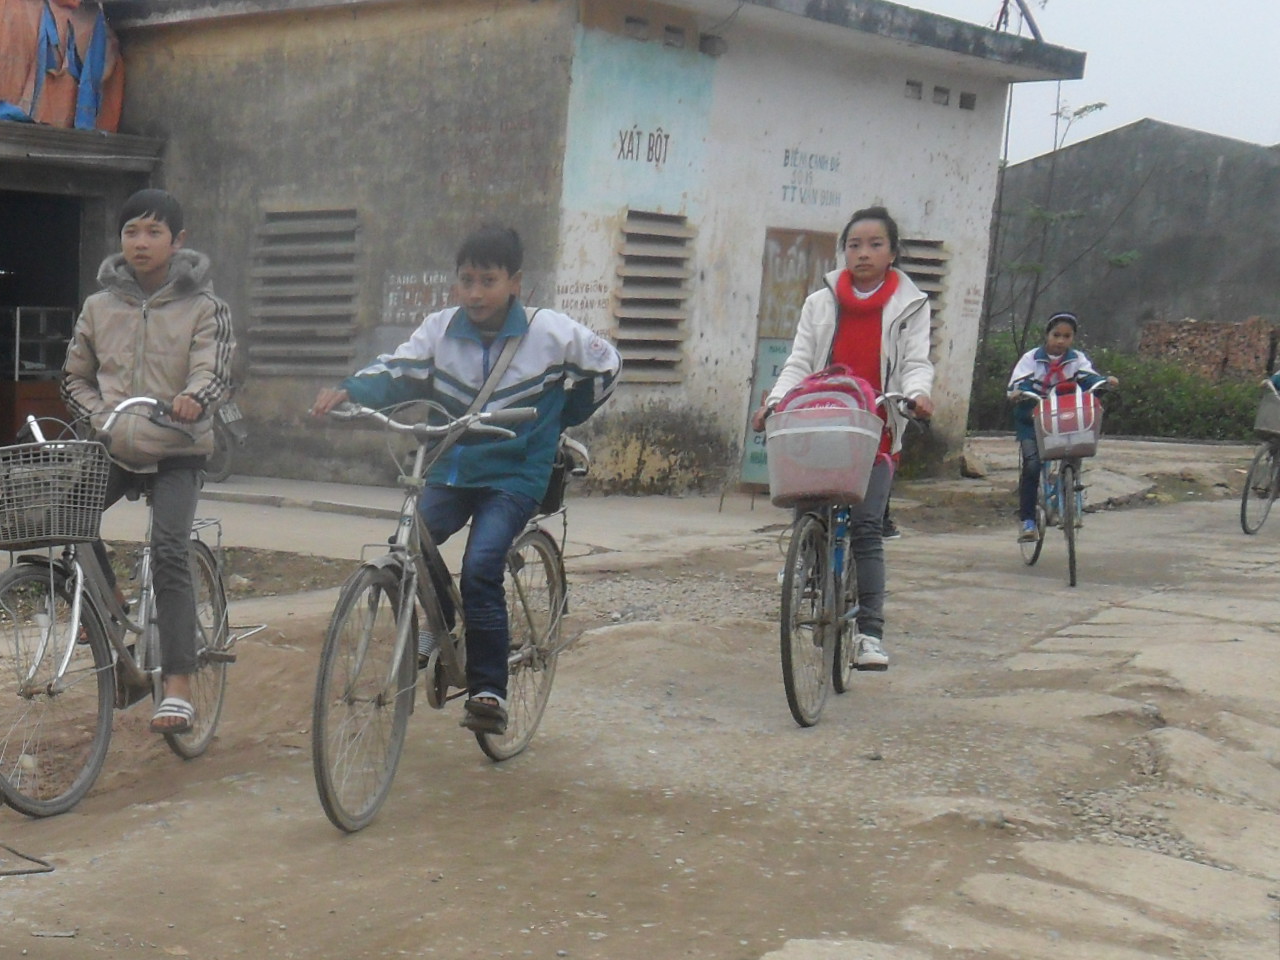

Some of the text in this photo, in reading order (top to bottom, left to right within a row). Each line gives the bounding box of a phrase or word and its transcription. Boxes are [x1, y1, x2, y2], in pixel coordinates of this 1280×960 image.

[617, 124, 670, 167] XÁT BỘT
[782, 185, 797, 202] TT
